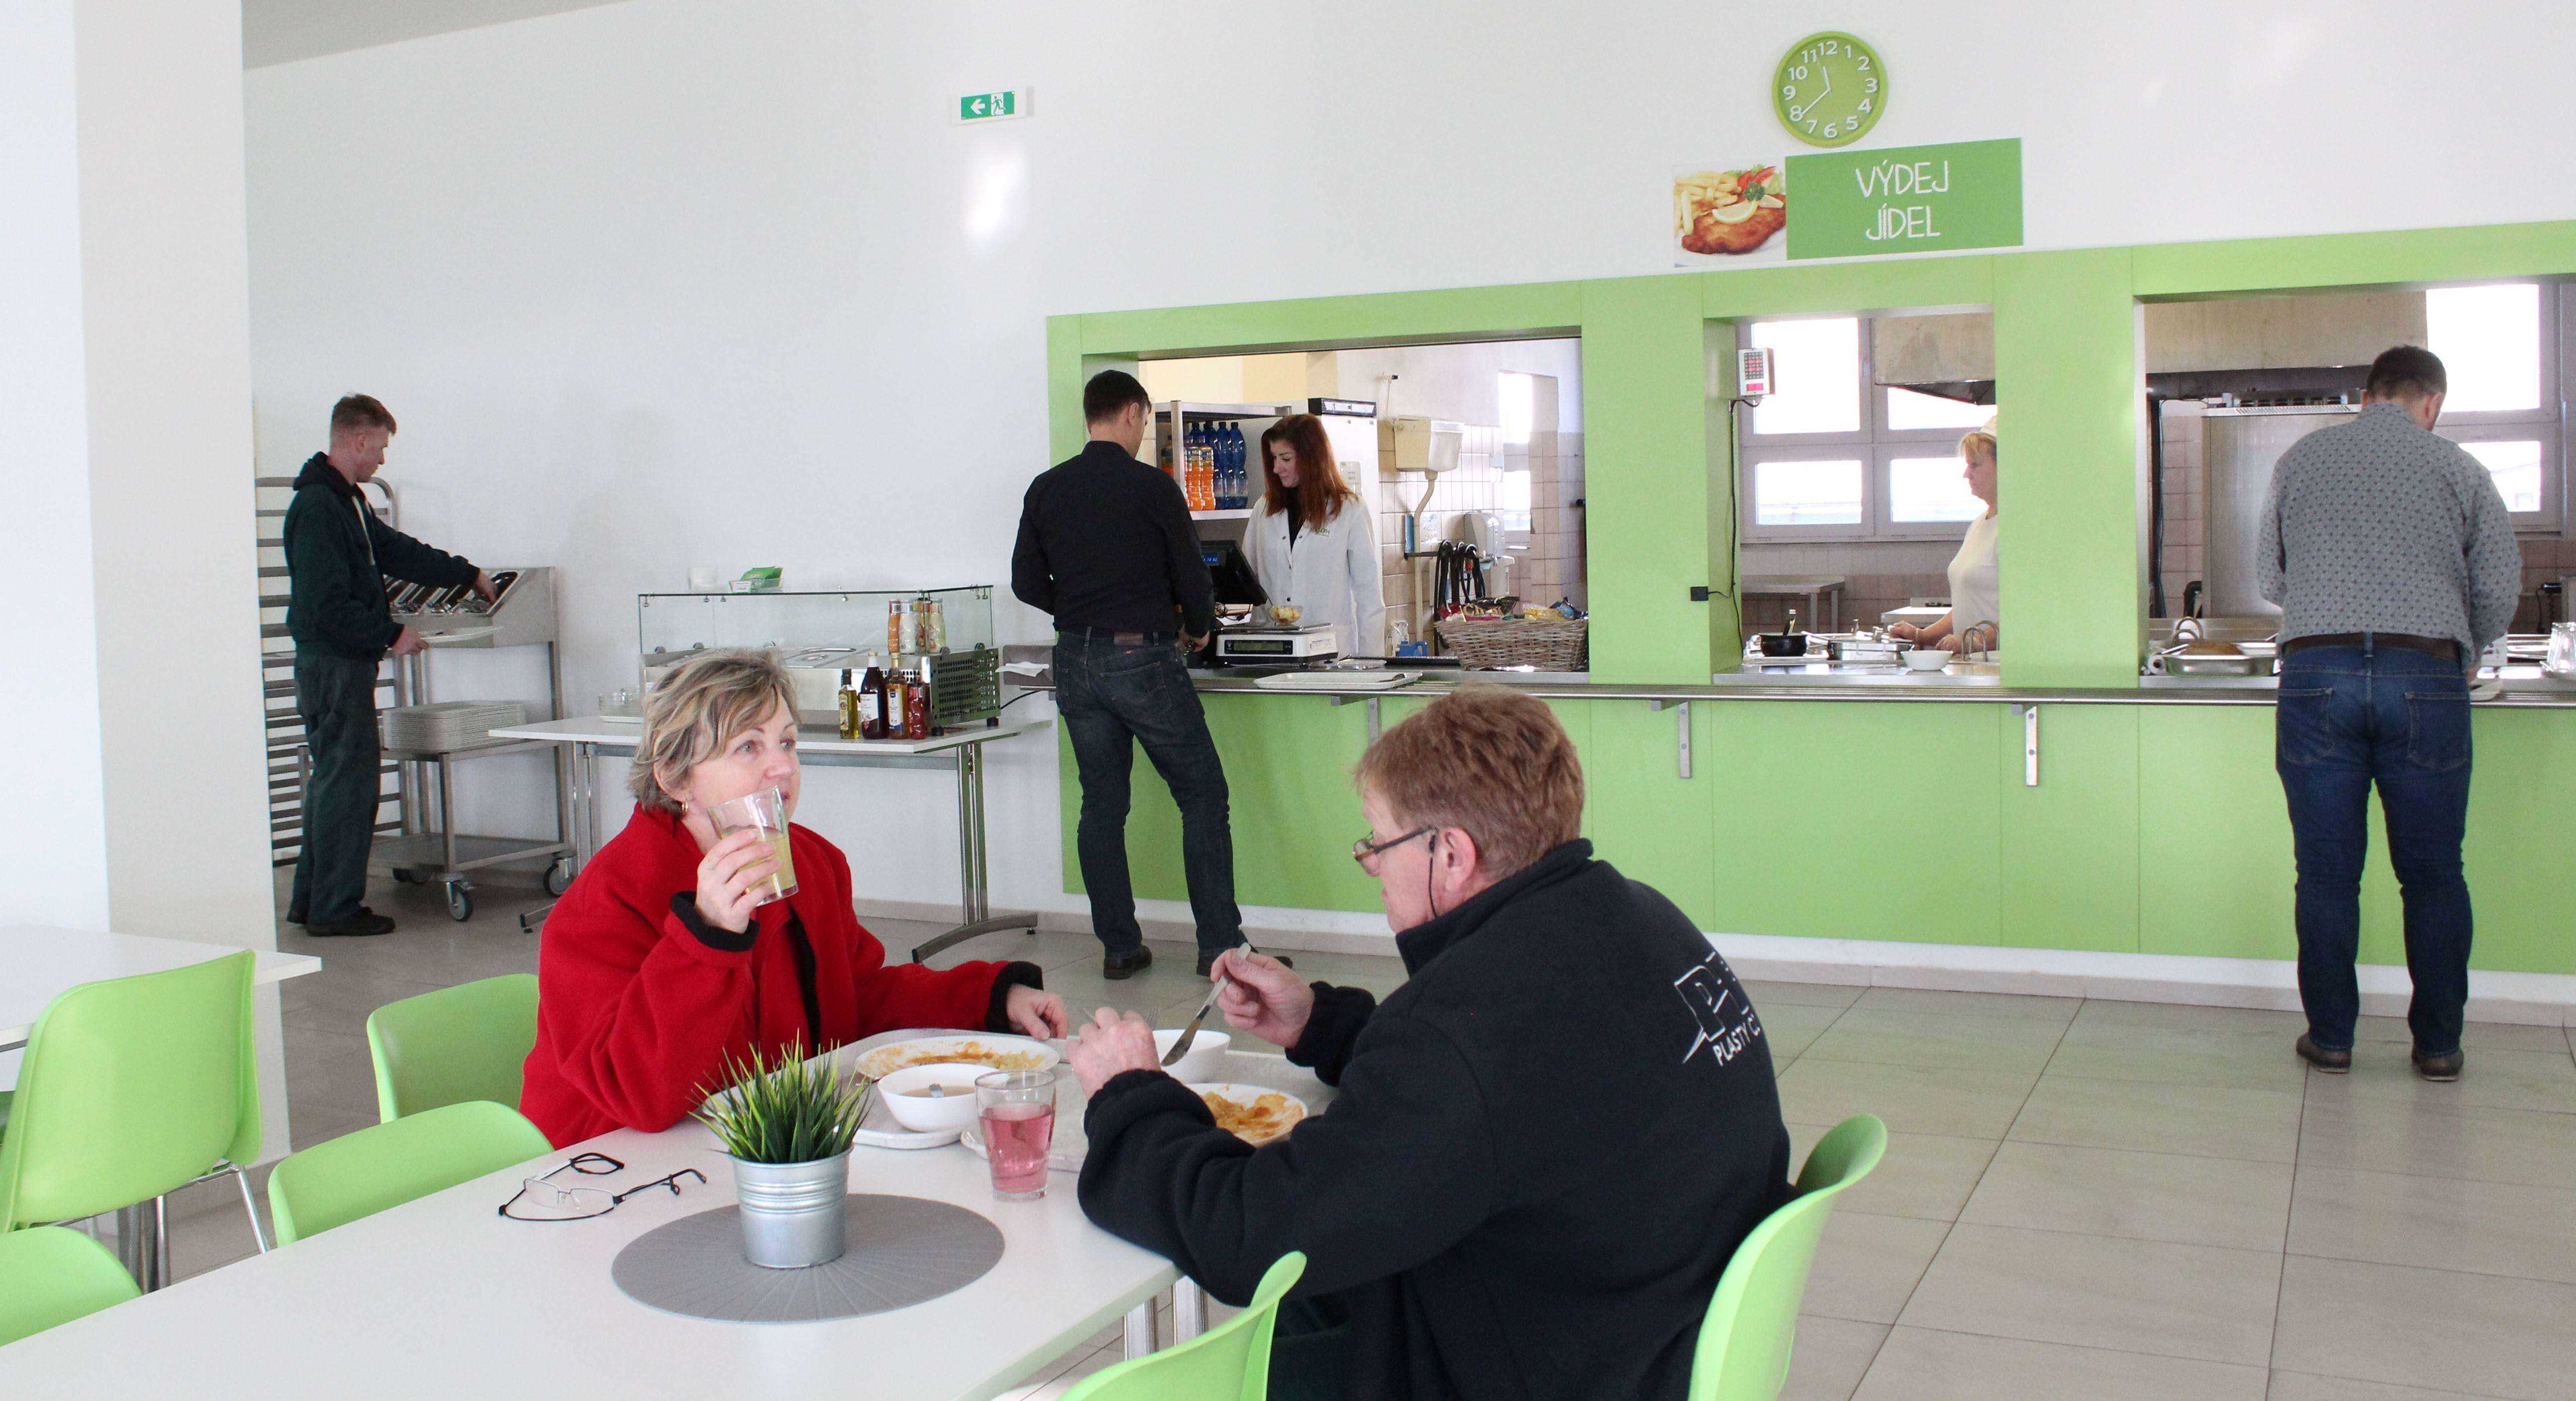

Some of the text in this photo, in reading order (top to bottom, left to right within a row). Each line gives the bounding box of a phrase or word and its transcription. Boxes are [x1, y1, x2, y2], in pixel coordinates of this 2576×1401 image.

[1801, 49, 1817, 64] 11
[1817, 41, 1838, 56] 12
[1845, 45, 1852, 59] 1
[1858, 56, 1870, 71] 2
[1788, 66, 1808, 81] 10
[1783, 85, 1796, 101] 9
[1865, 78, 1878, 94] 3
[1790, 105, 1803, 122] 8
[1858, 98, 1872, 114] 4
[1806, 119, 1818, 134] 7
[1823, 123, 1838, 138] 6
[1846, 115, 1859, 131] 5
[1855, 159, 1949, 198] VÝDEJ
[1865, 203, 1941, 240] JÍDEL
[1712, 1022, 1751, 1066] PLASTY
